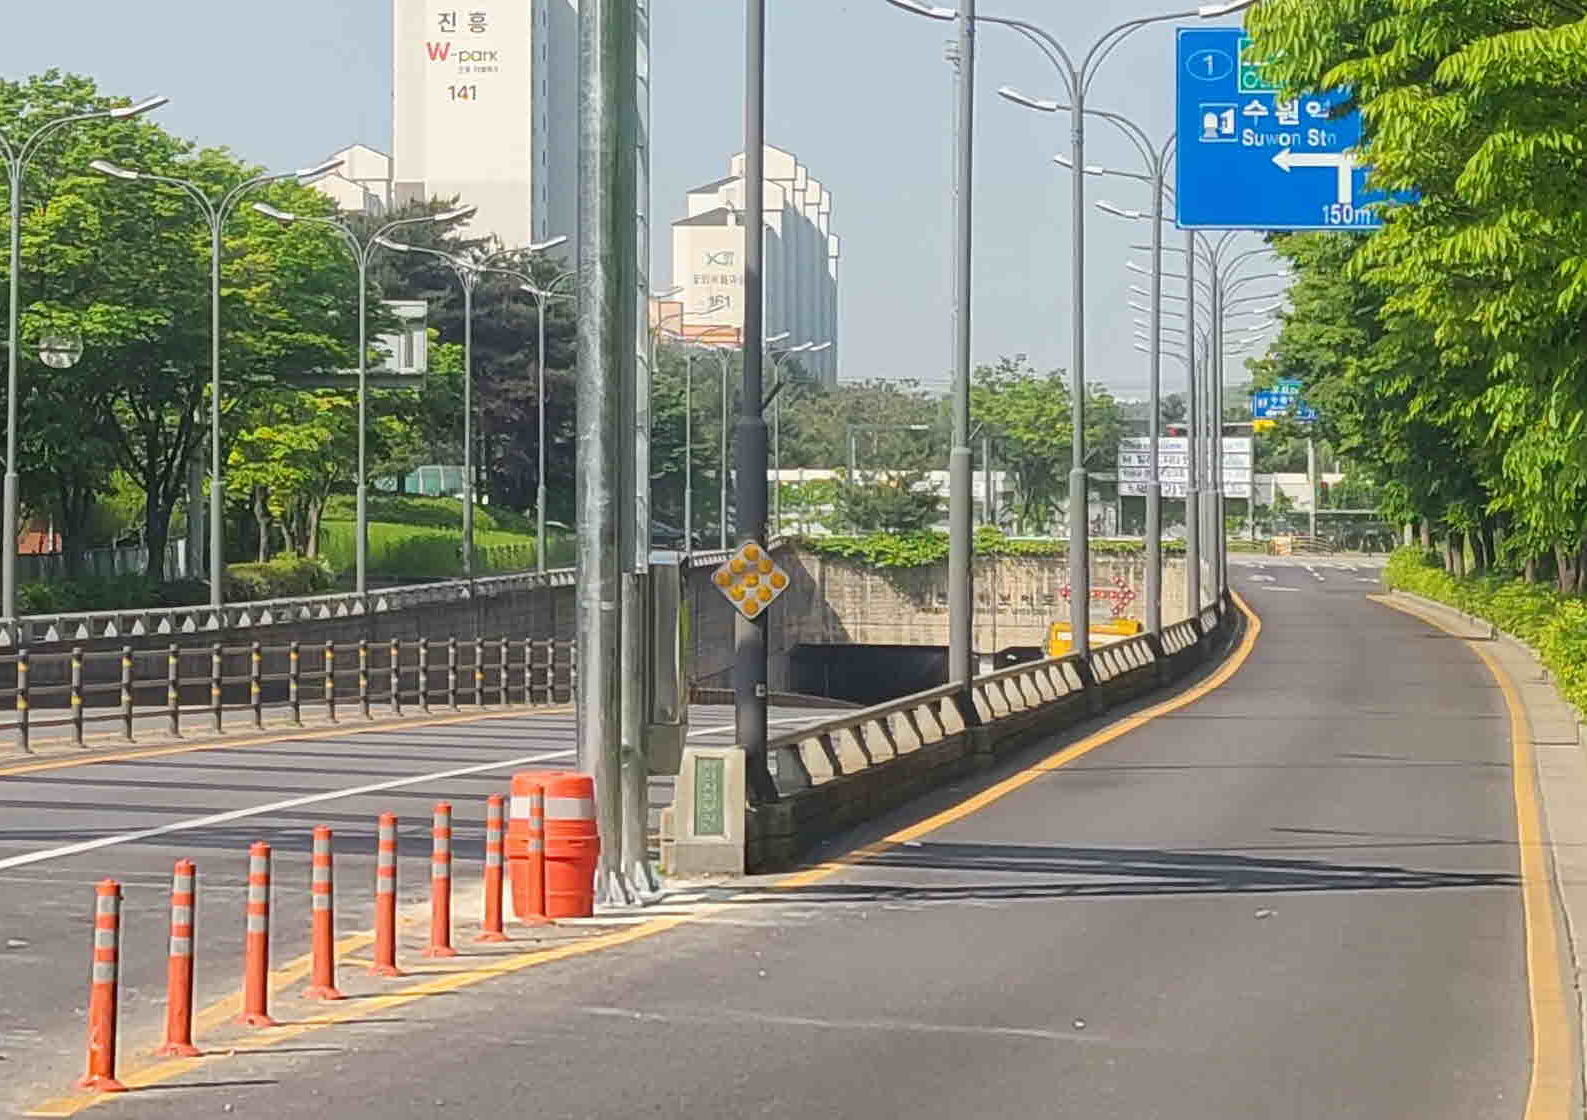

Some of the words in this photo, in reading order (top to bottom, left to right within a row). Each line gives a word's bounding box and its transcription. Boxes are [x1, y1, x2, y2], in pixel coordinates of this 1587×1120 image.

[426, 41, 498, 64] W-park
[1202, 55, 1214, 76] 1
[447, 84, 477, 101] 141
[1242, 128, 1301, 147] Suwon
[1307, 128, 1336, 147] Stn
[1322, 203, 1371, 225] 150m
